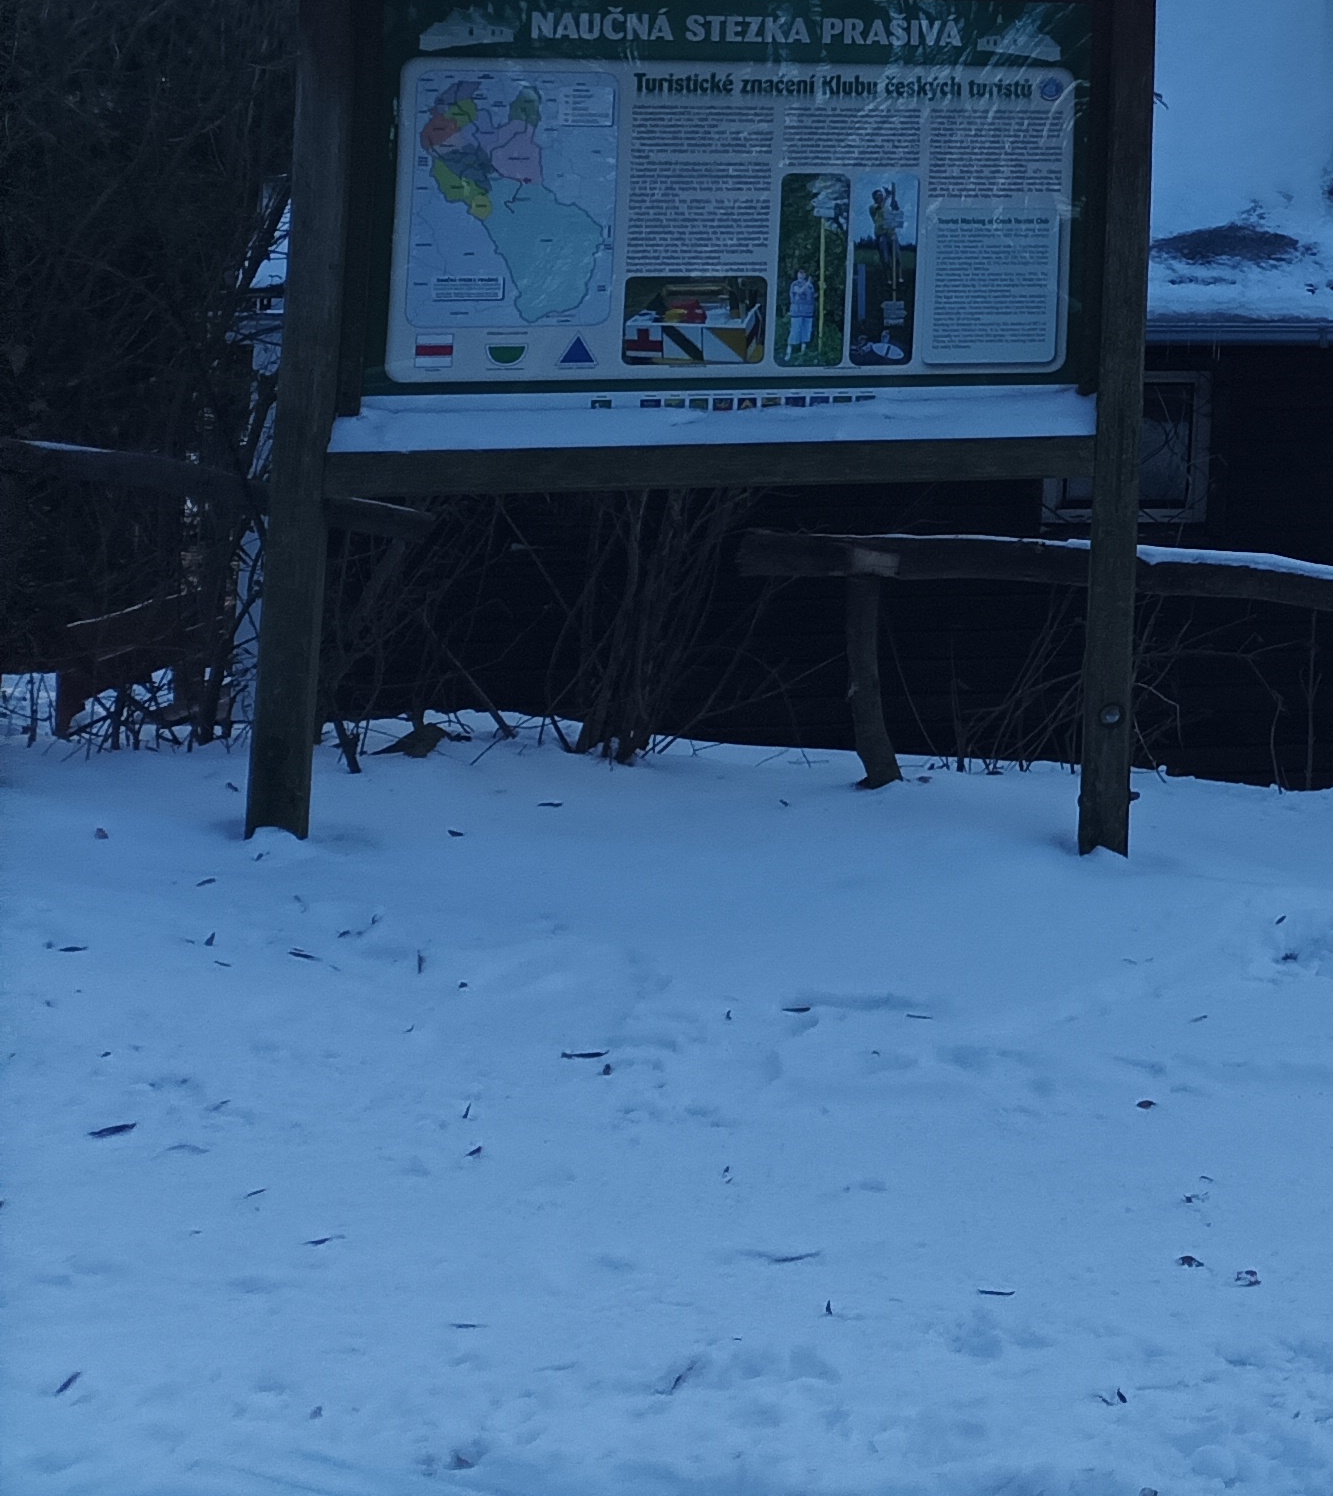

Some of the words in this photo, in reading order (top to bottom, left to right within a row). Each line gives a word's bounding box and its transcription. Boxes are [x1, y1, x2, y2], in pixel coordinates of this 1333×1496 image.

[530, 6, 673, 42] NAUČNÁ
[685, 13, 811, 44] STEZKA
[822, 12, 963, 48] PRAŠIVÁ
[633, 71, 734, 96] Turistické
[740, 73, 815, 97] značení
[821, 75, 878, 97] Klubu
[885, 73, 961, 101] českých
[969, 75, 1033, 99] turistů
